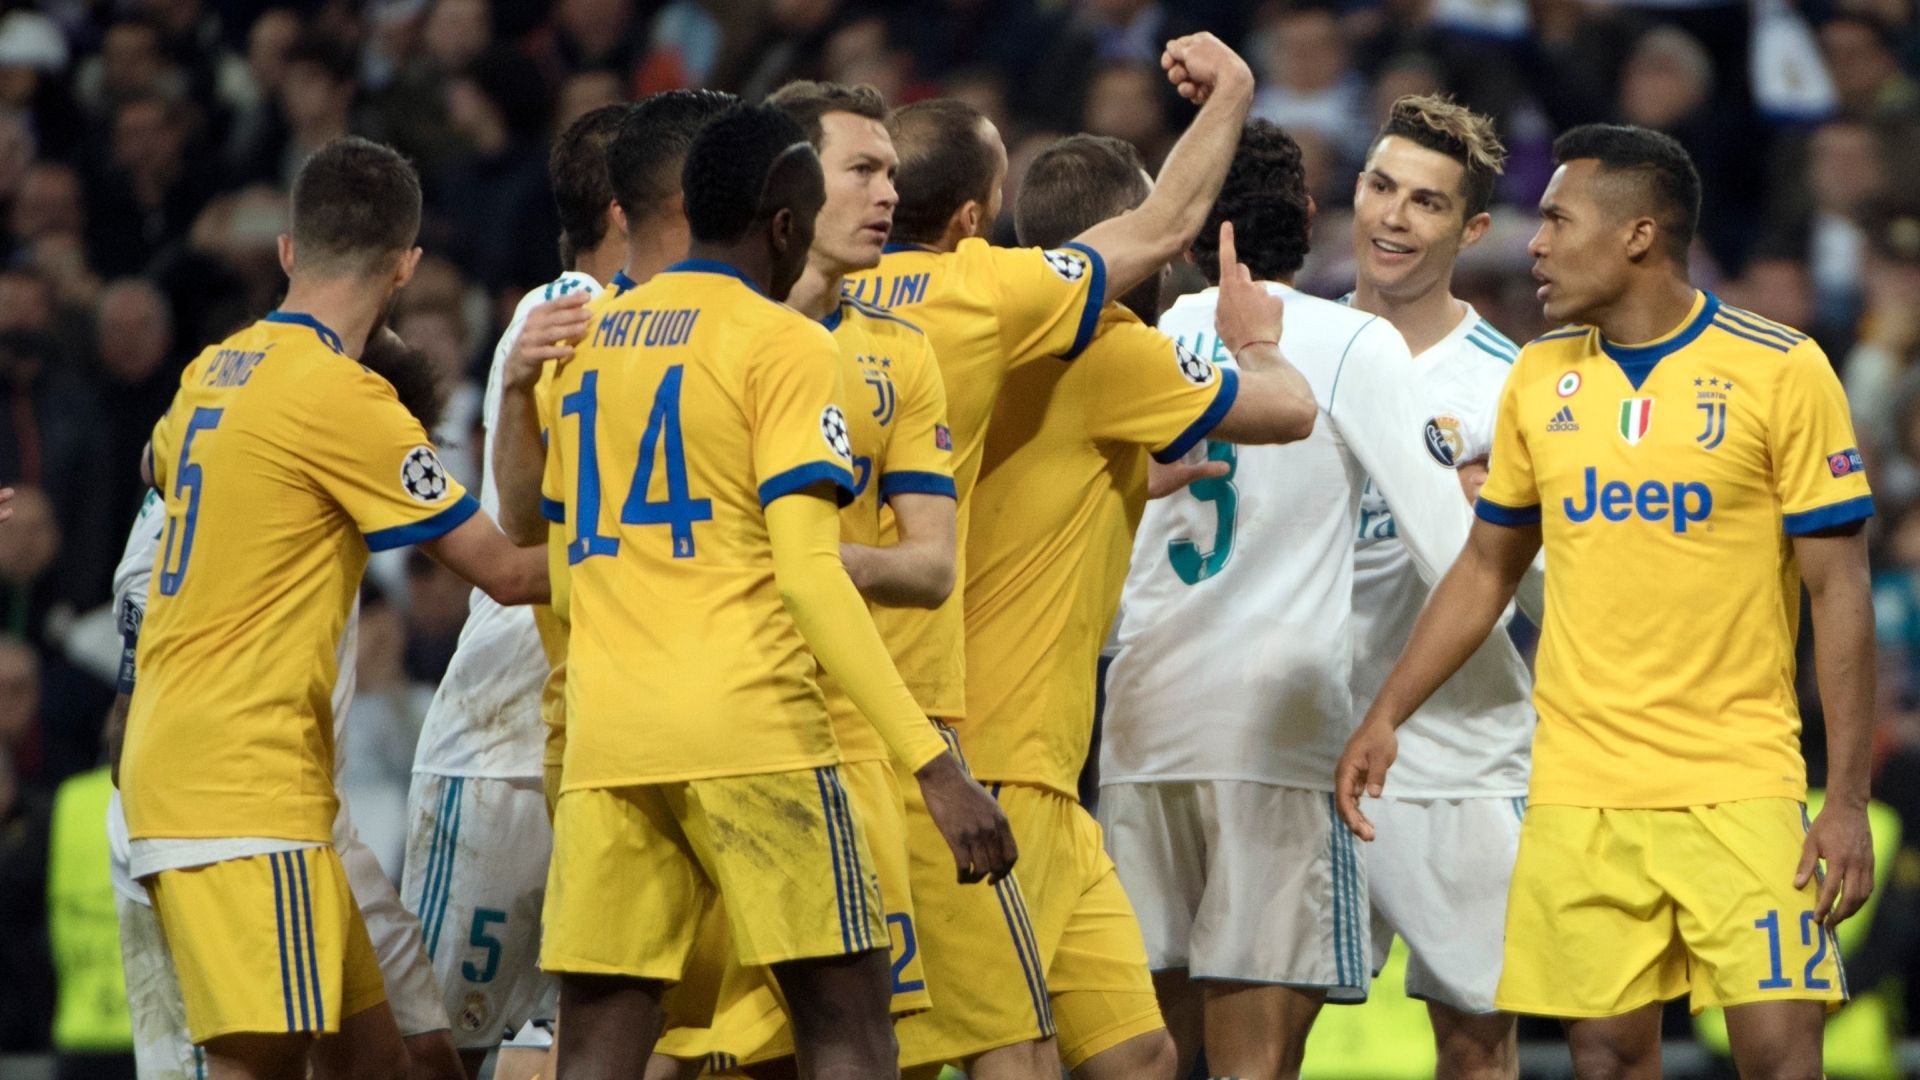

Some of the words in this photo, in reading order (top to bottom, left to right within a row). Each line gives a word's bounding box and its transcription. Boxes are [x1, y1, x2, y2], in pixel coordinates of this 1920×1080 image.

[592, 309, 701, 347] MATUIDI
[562, 364, 713, 566] 14
[1546, 421, 1580, 432] adidas
[160, 406, 224, 596] 5
[1168, 438, 1238, 586] 3
[1563, 467, 1713, 532] Jeep
[461, 906, 506, 983] 5
[1755, 910, 1831, 989] 12
